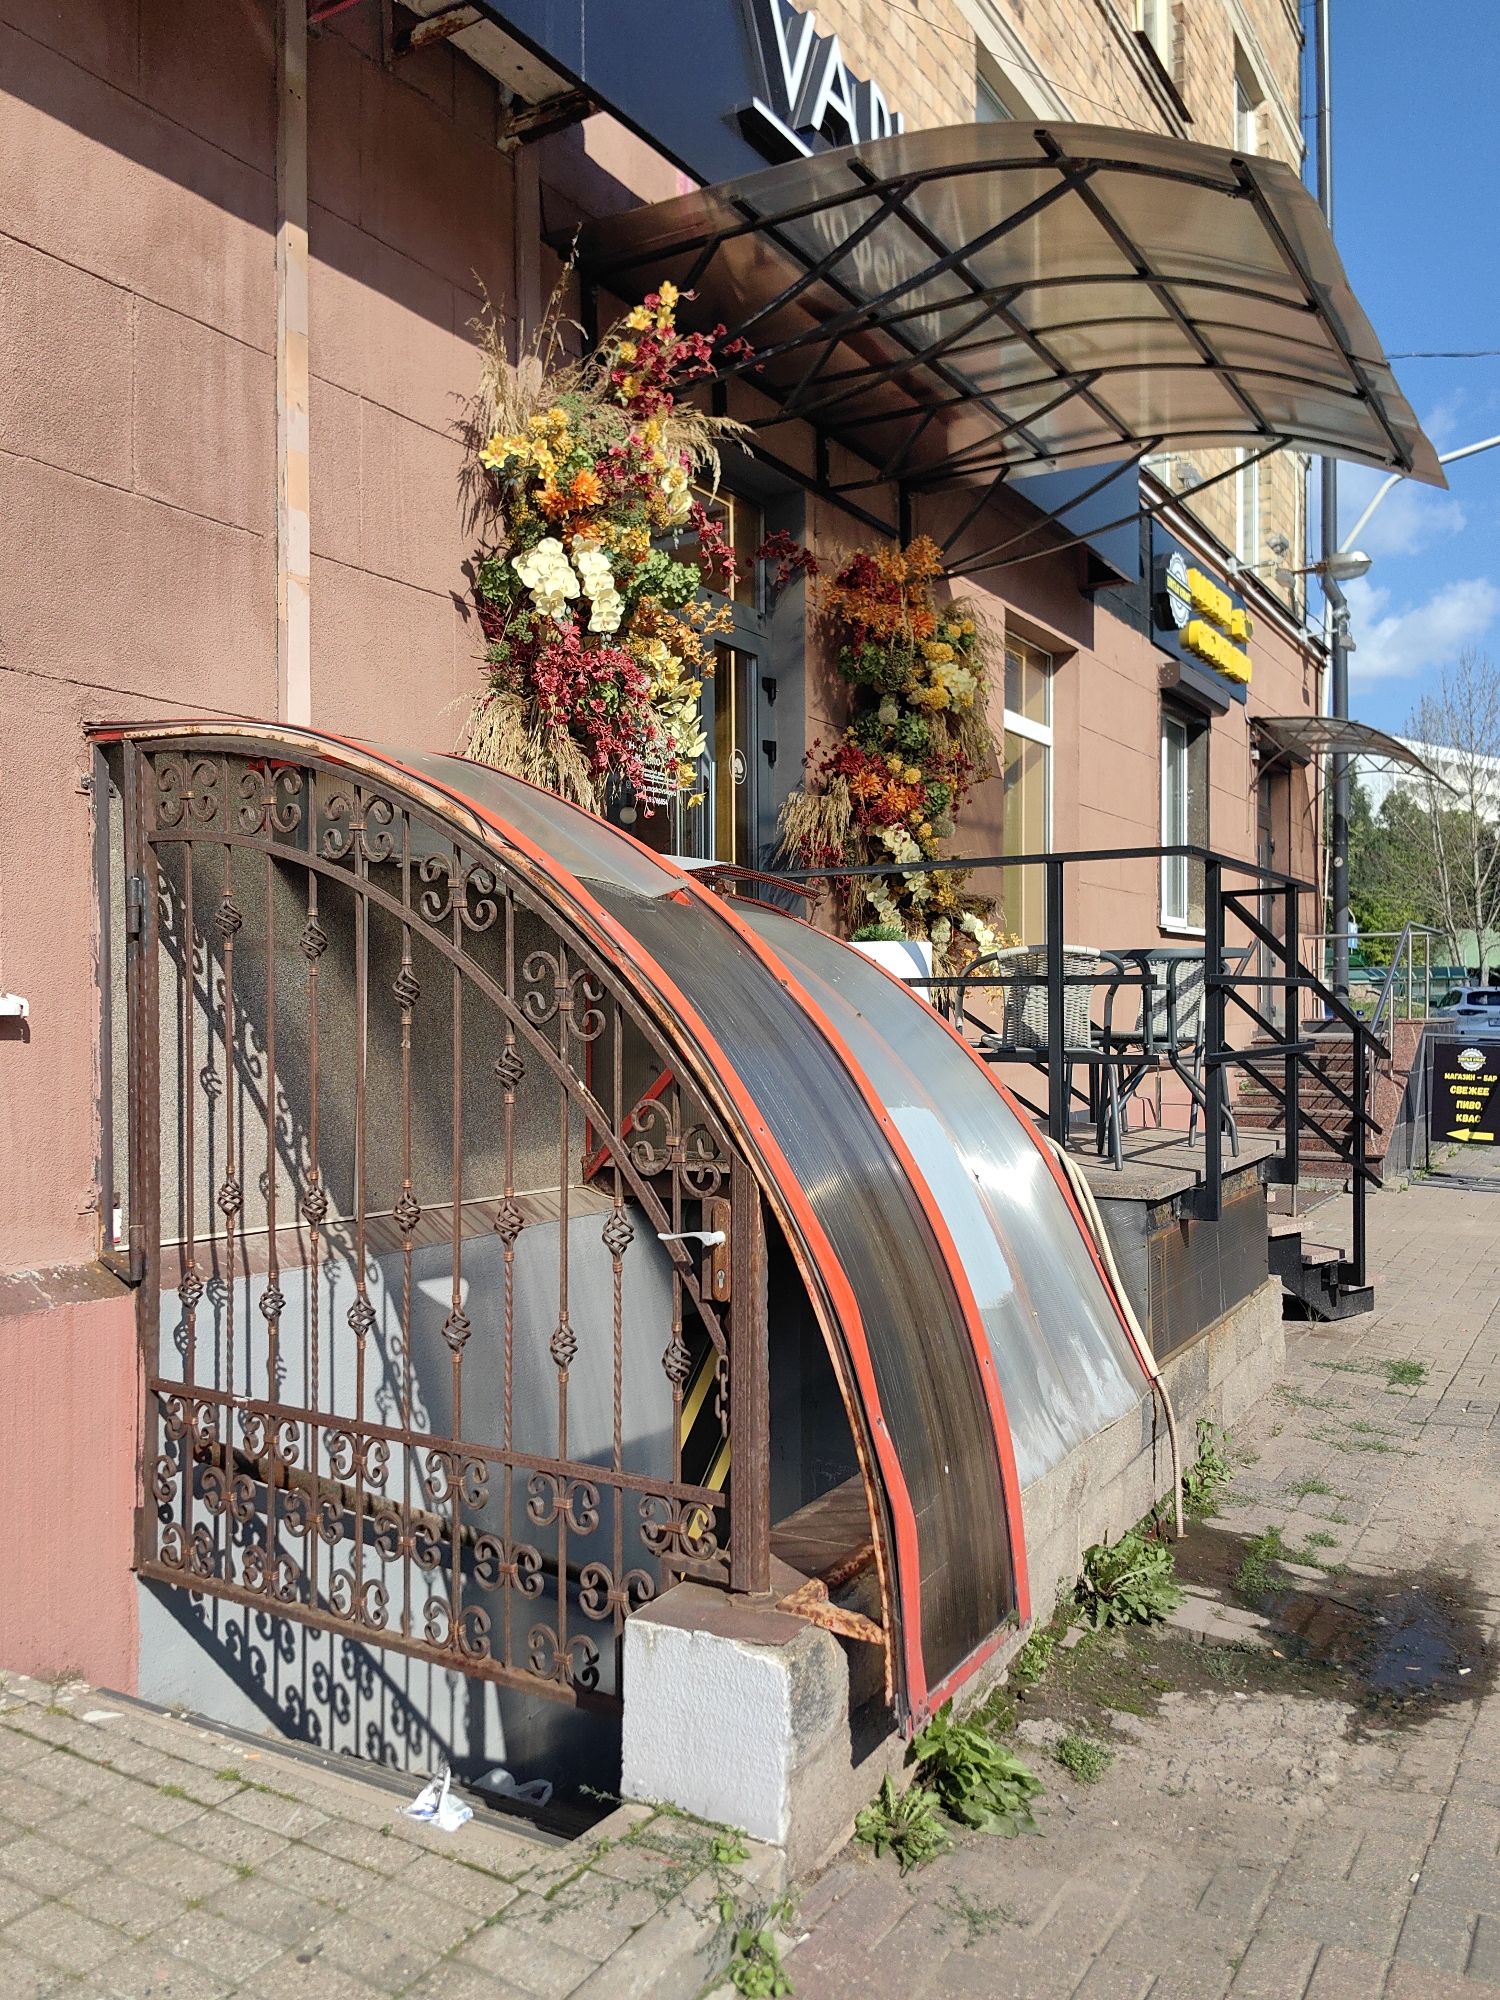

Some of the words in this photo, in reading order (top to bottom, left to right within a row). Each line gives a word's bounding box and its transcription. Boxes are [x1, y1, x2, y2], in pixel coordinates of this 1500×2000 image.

[768, 0, 905, 146] VAD
[1444, 1072, 1476, 1081] МАГАЗИН
[1483, 1074, 1498, 1083] БАР
[1449, 1085, 1490, 1097] СВЕЖЕЕ
[1456, 1100, 1483, 1111] ПИВО,
[1455, 1114, 1482, 1123] КВАС
